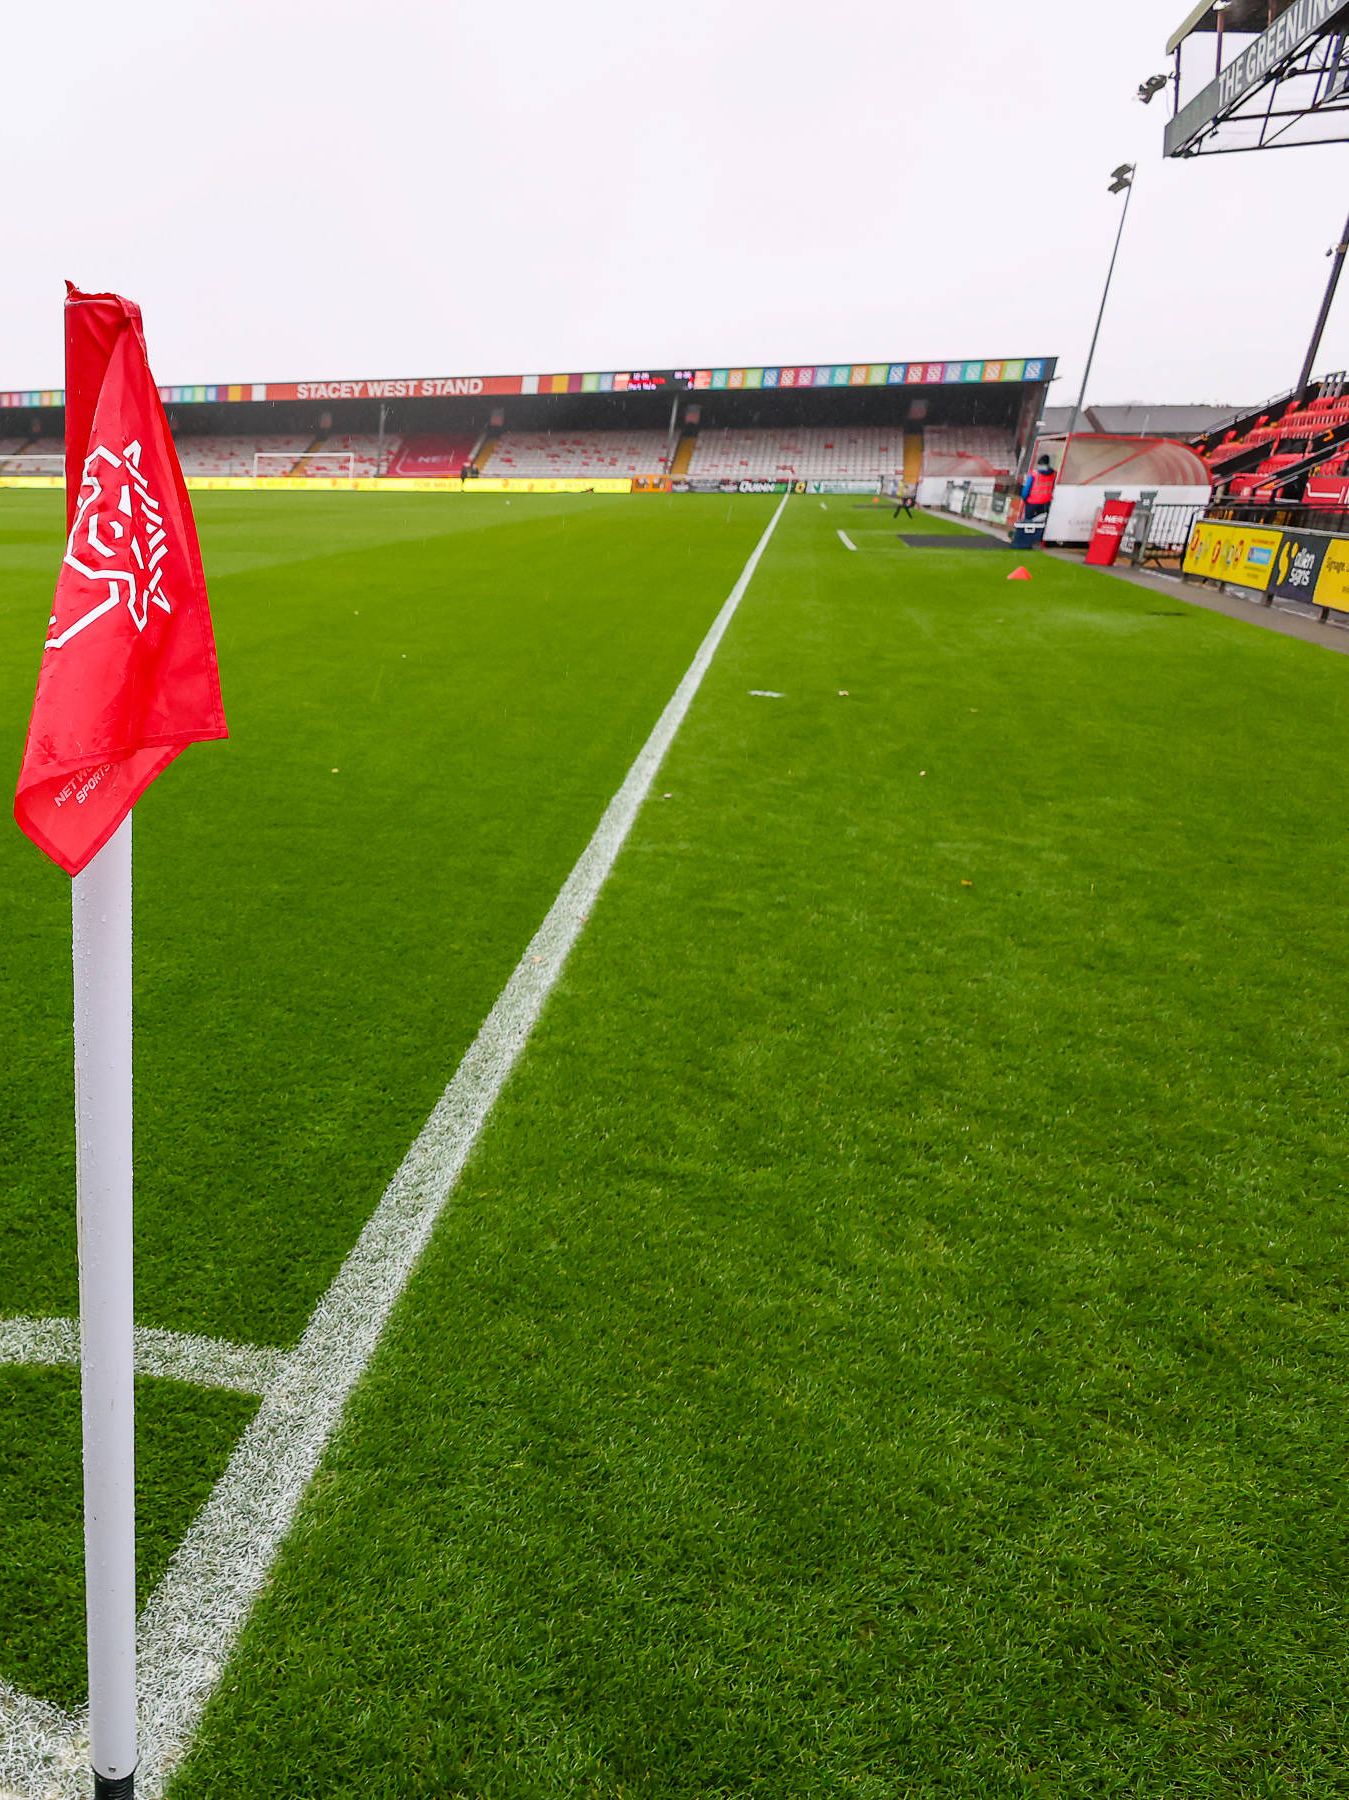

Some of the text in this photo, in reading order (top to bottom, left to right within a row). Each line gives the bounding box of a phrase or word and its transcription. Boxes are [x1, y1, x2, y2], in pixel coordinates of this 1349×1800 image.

[1218, 58, 1244, 108] THE
[296, 378, 484, 400] STACEY WEST STAND
